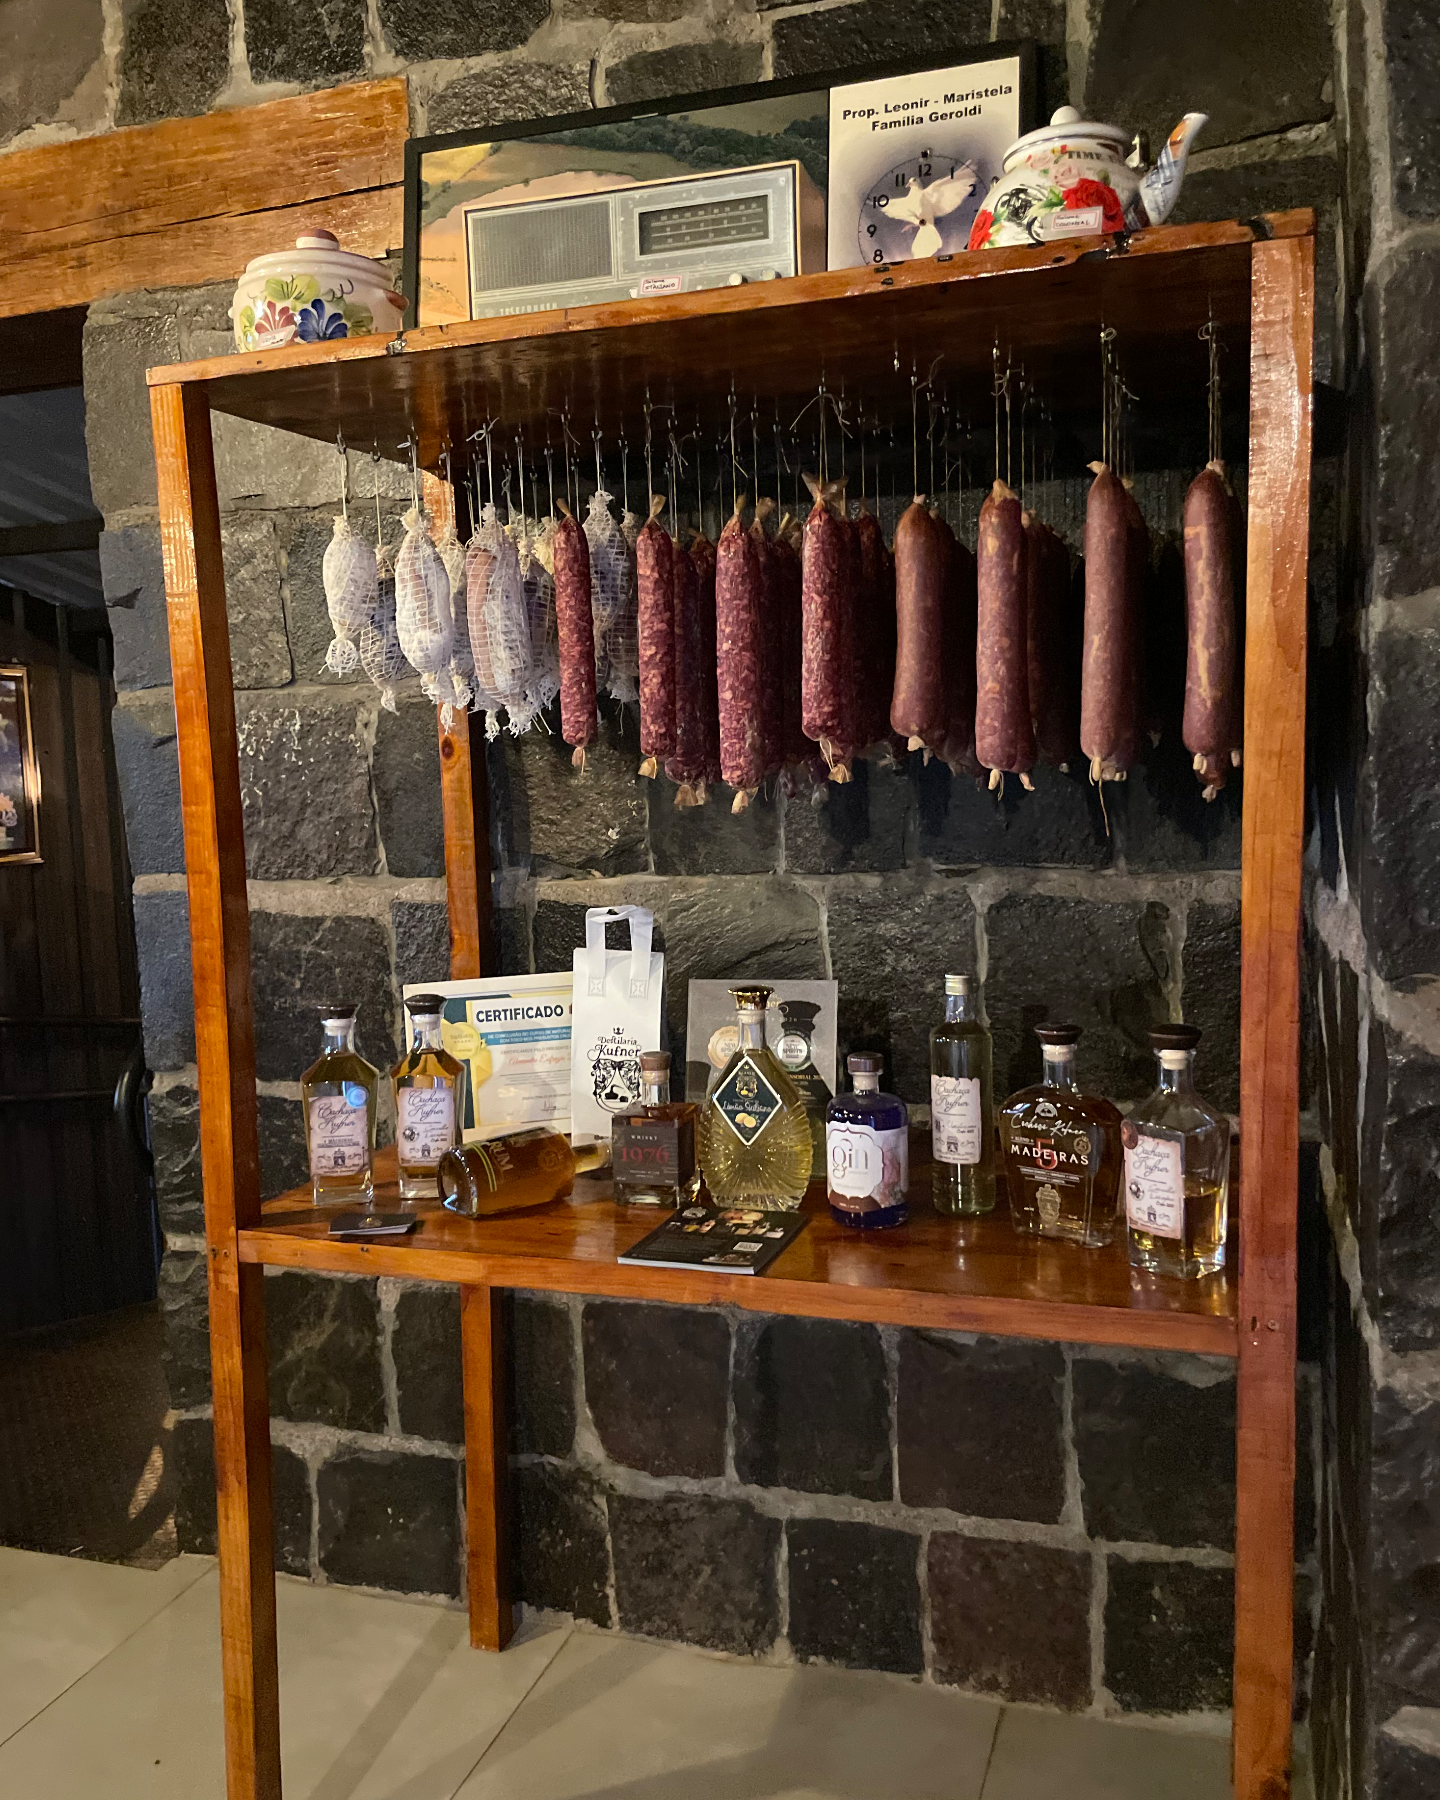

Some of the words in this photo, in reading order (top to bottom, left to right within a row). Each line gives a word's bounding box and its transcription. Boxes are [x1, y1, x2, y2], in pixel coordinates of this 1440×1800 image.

[843, 108, 879, 120] Prop.
[884, 98, 930, 114] Leonir
[943, 85, 1013, 105] Maristela
[929, 105, 982, 123] Geroldi
[918, 163, 932, 177] 12
[950, 166, 955, 179] 1
[895, 173, 905, 187] 11
[968, 184, 977, 197] 2
[872, 194, 890, 209] 10
[866, 224, 877, 238] 9
[873, 249, 884, 264] 8
[500, 302, 558, 316] TELEFUNKEN
[476, 1004, 564, 1023] CERTIFICADO
[598, 1036, 638, 1046] Destilaria
[587, 1044, 642, 1061] Kufner
[935, 1080, 970, 1096] Cachaça
[408, 1090, 446, 1107] Cachaça
[935, 1094, 969, 1112] Kufner
[317, 1102, 357, 1119] Cachaça
[408, 1104, 444, 1121] Kufner
[318, 1115, 356, 1134] Kufner
[621, 1146, 670, 1166] 1976
[832, 1138, 868, 1179] gin
[1011, 1144, 1089, 1166] MADEIRAS
[1036, 1137, 1058, 1170] 5
[1132, 1157, 1169, 1177] Kufner
